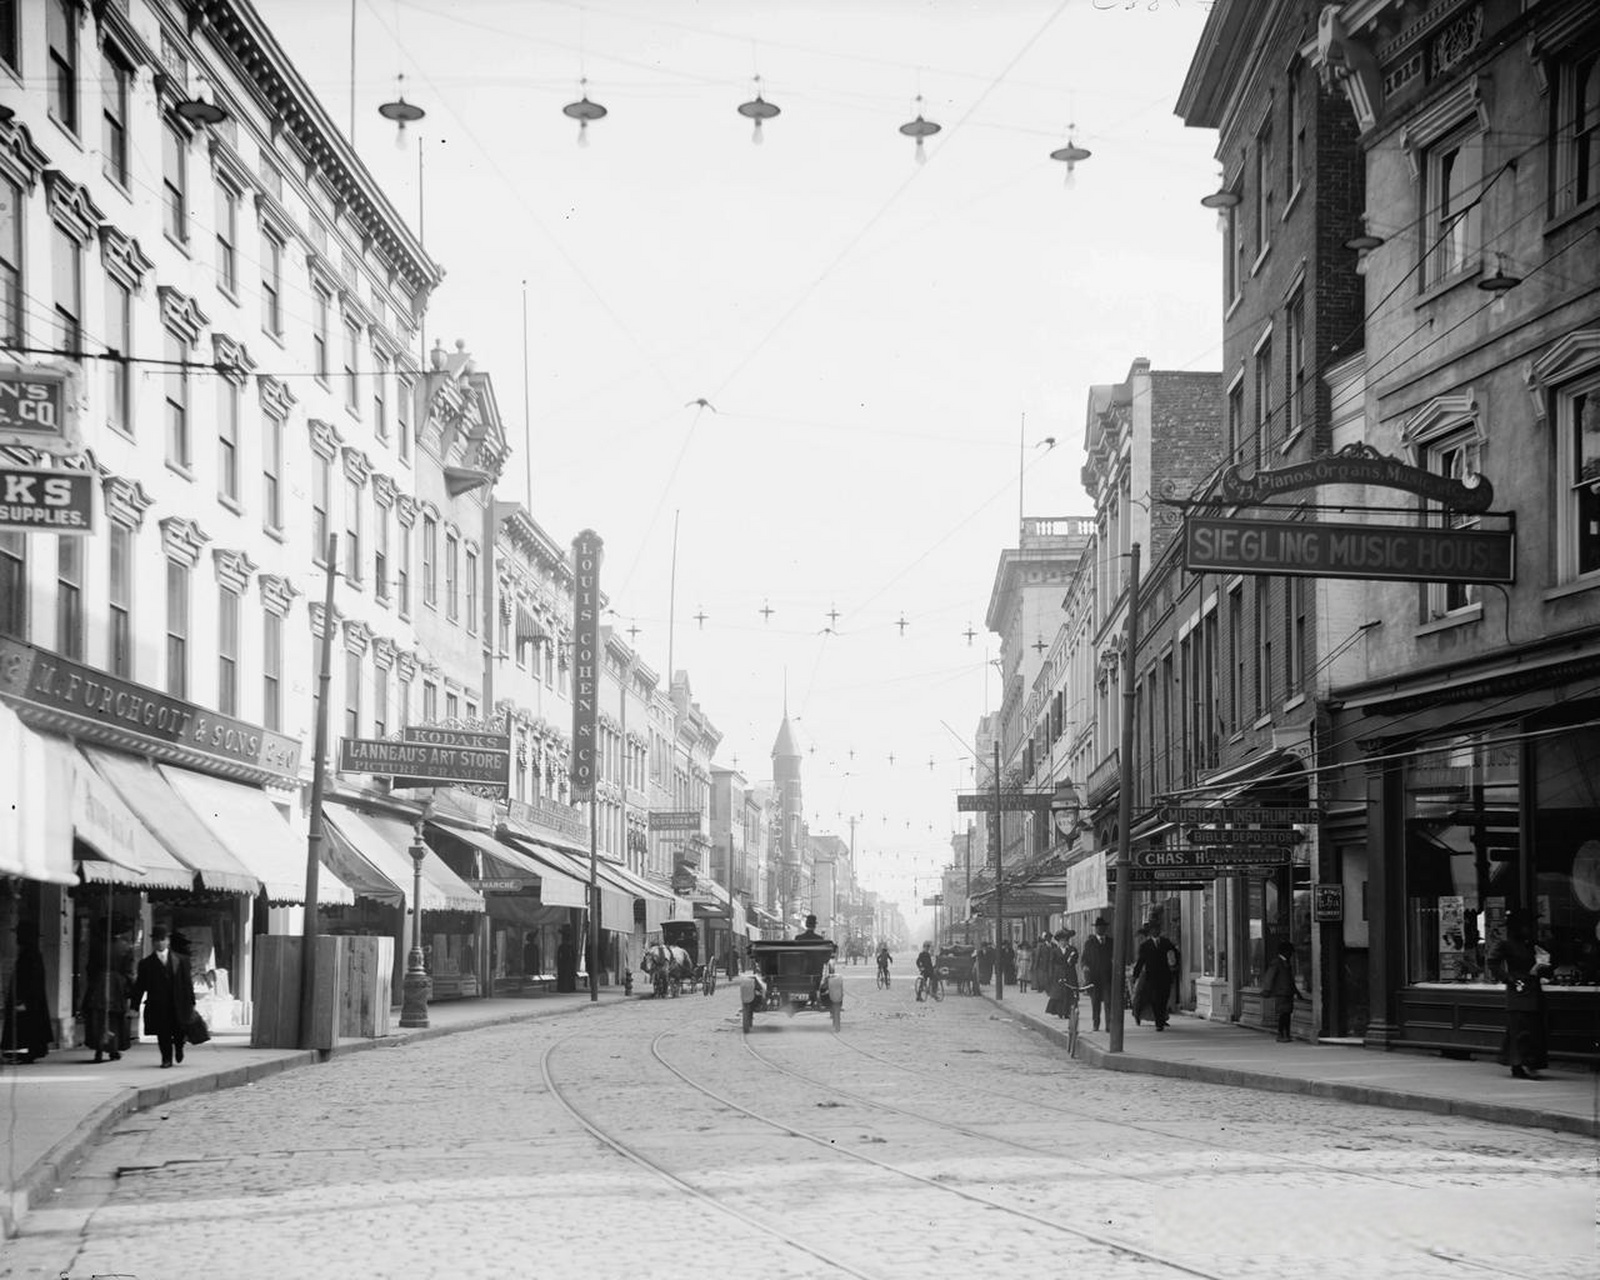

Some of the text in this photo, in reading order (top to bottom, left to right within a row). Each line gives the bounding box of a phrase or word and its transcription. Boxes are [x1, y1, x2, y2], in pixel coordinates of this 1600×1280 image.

[1194, 528, 1318, 565] SIEGLING
[1329, 534, 1408, 567] MUSIC
[580, 543, 593, 621] LOUIS
[579, 633, 592, 711] COHEN
[64, 673, 193, 736] FURCHGOTT
[195, 718, 208, 742] &
[414, 730, 499, 747] KODAKS
[579, 725, 592, 737] &
[349, 741, 502, 770] LANNEAU'S ART STORE
[355, 761, 493, 780] PICTURE FRAMES
[1169, 809, 1320, 823] MUSICAL INSTRUMENTS
[1194, 831, 1228, 842] BIBLE
[1145, 852, 1189, 865] CHAS.
